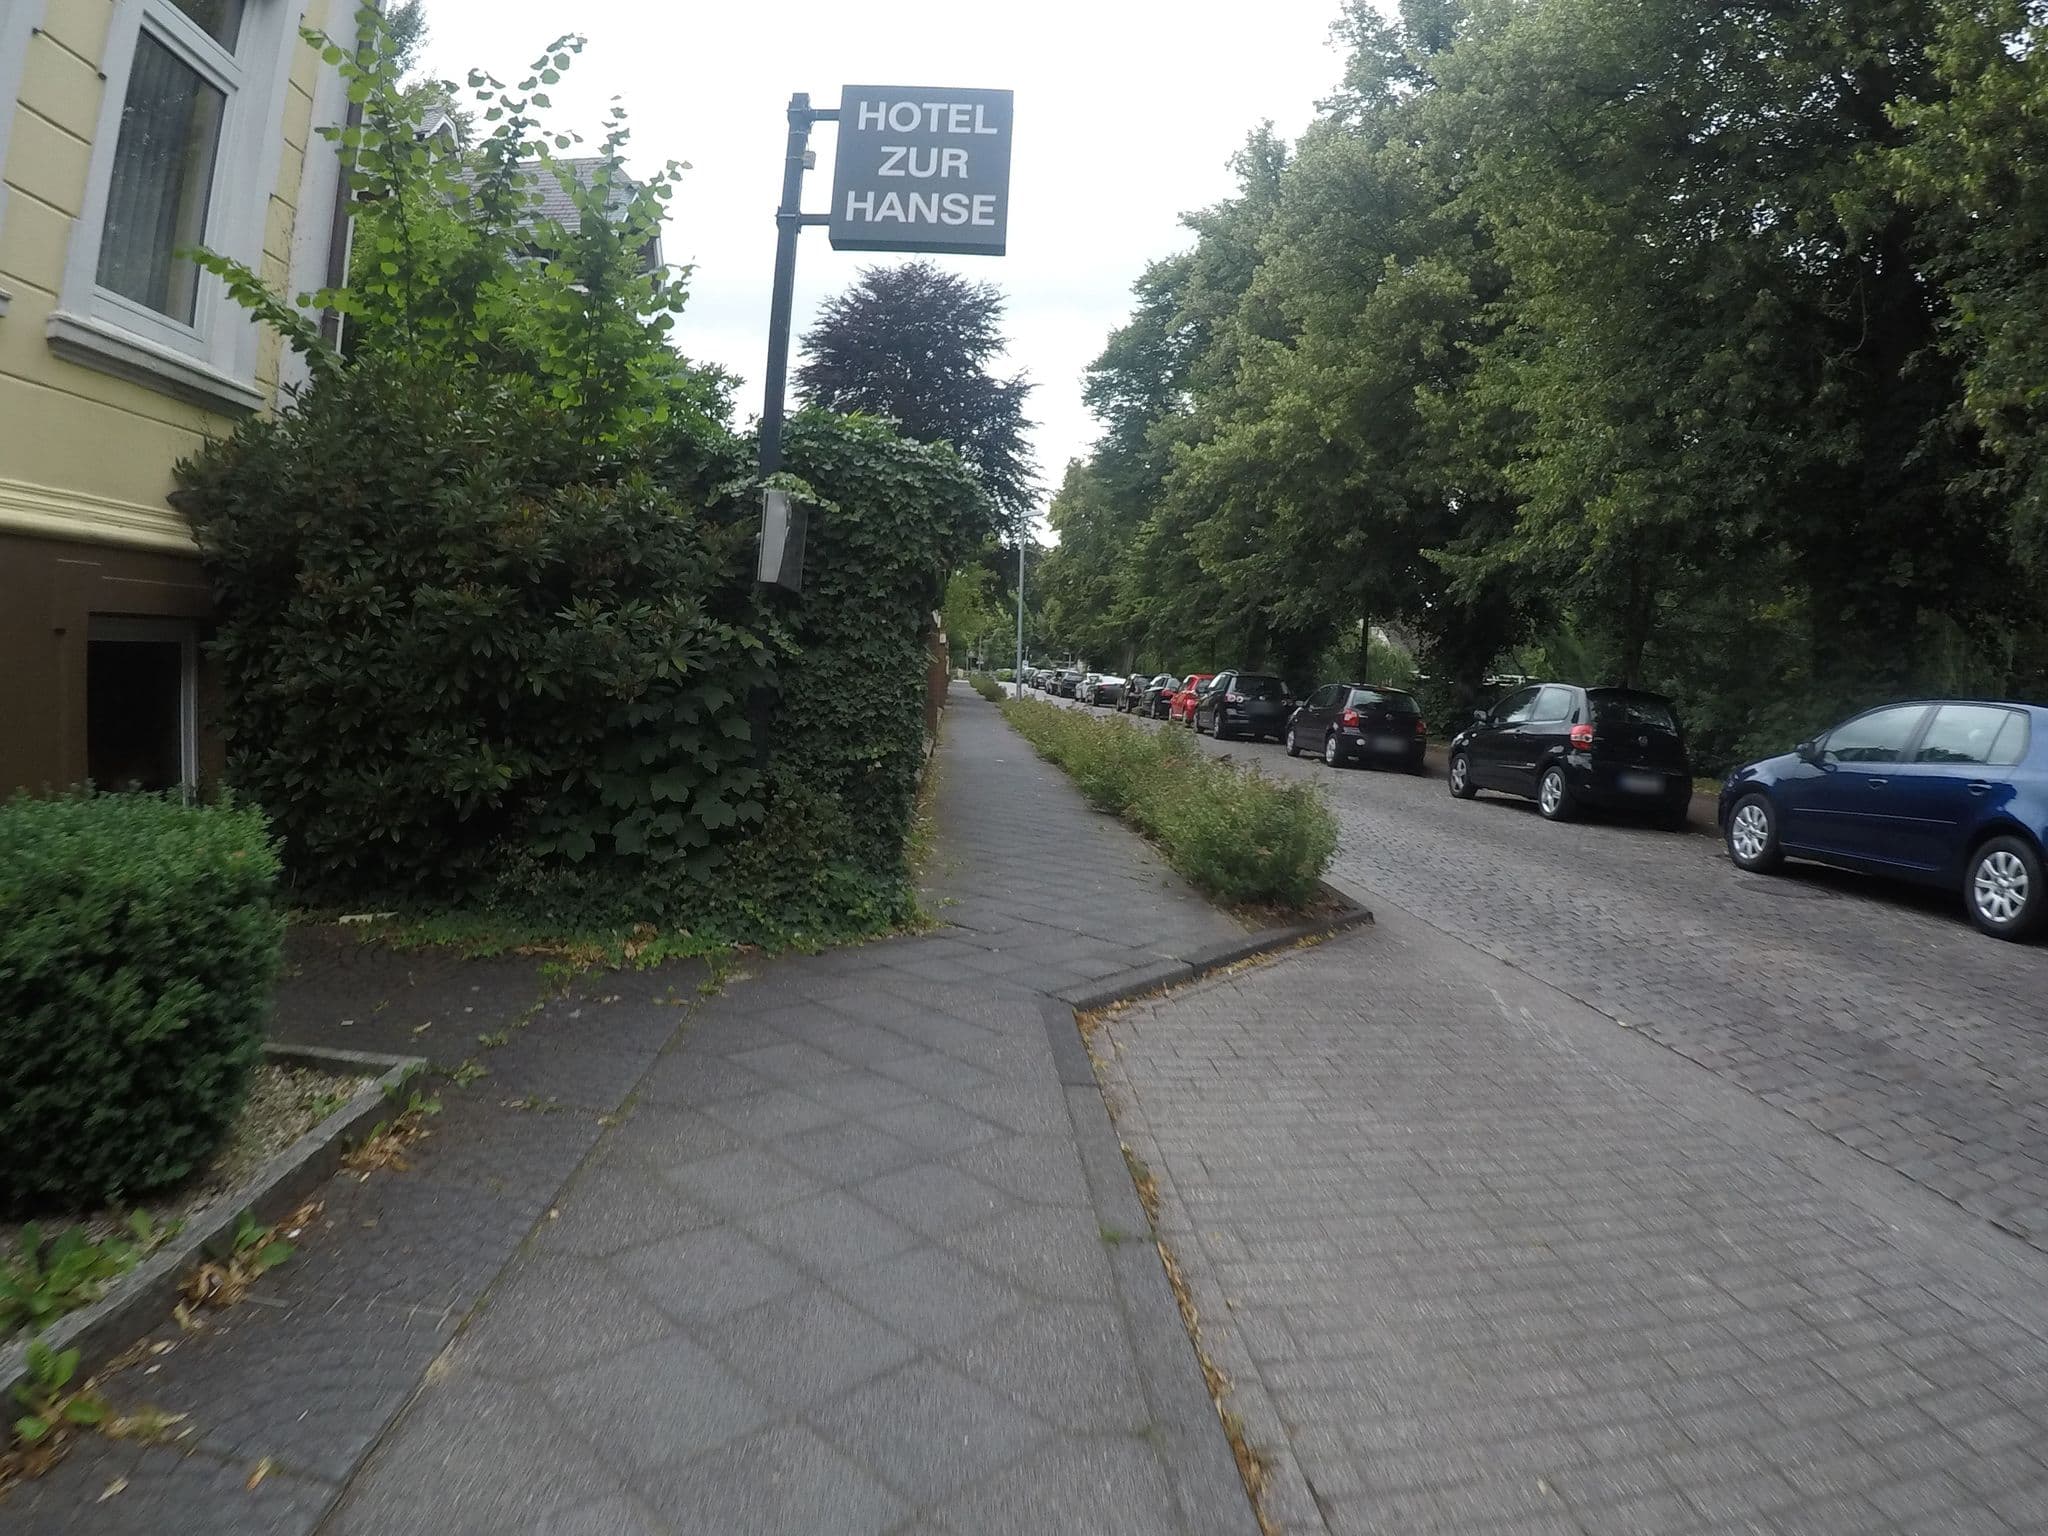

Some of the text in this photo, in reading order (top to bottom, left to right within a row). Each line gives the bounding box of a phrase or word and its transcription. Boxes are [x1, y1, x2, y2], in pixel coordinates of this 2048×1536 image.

[858, 101, 998, 134] HOTEL
[878, 146, 969, 179] ZUR
[845, 190, 997, 226] HANSE
